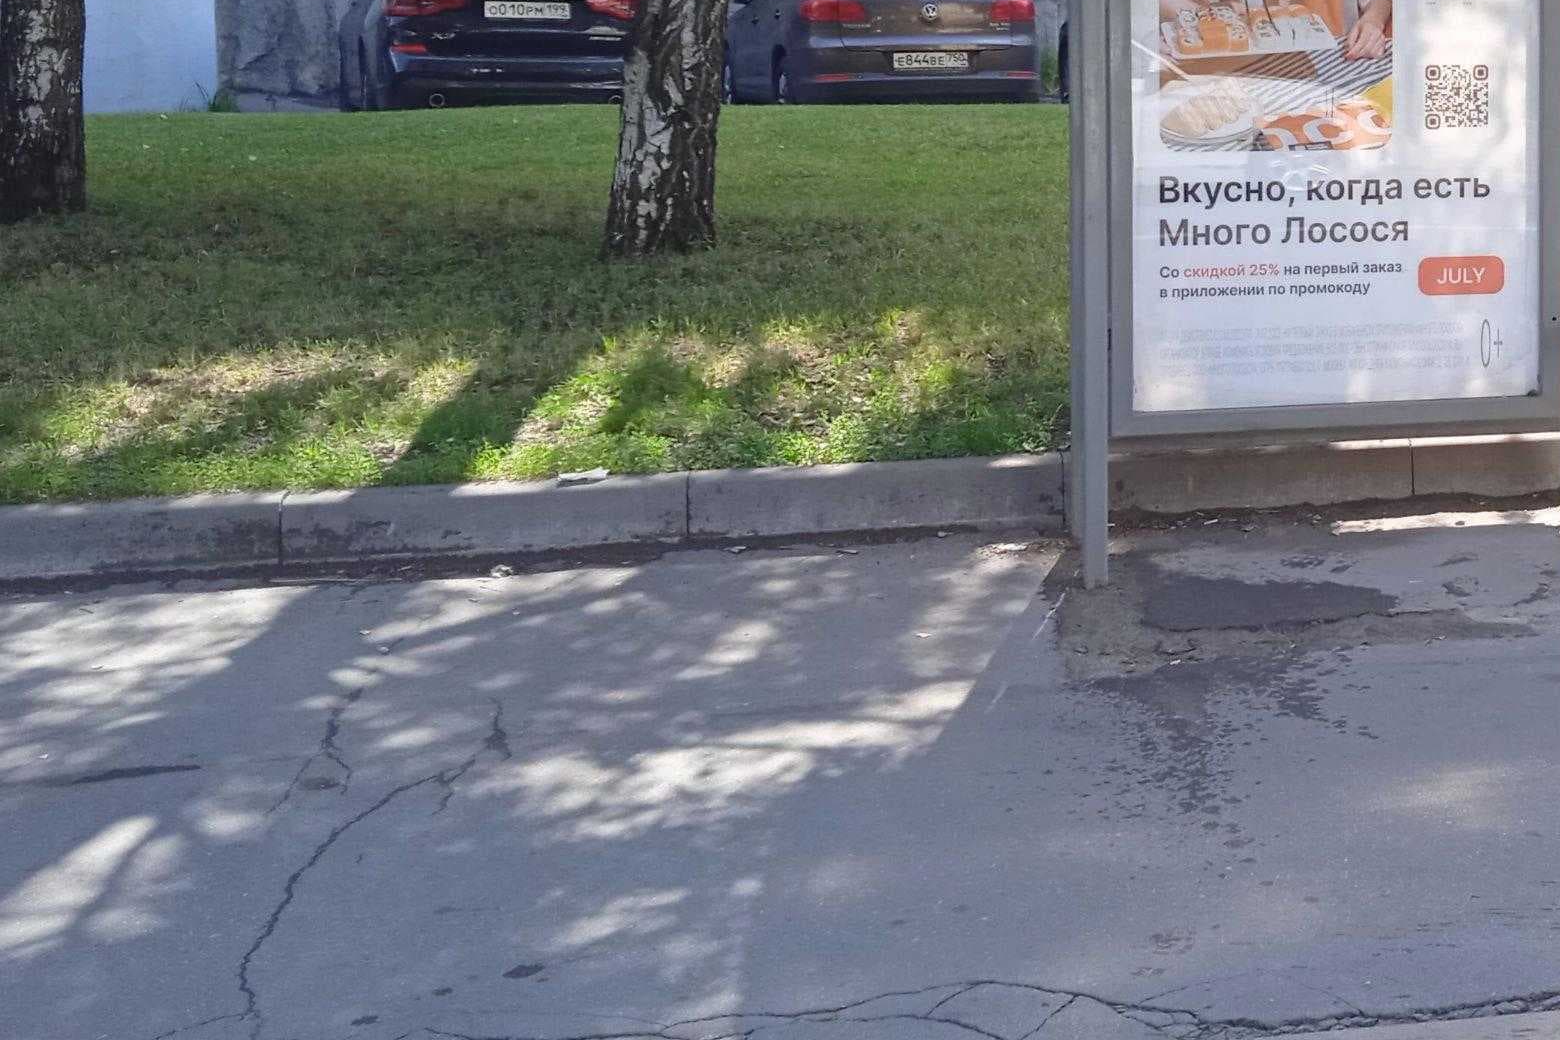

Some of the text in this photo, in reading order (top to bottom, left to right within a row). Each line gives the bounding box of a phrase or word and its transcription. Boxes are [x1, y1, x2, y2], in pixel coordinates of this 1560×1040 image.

[1159, 175, 1491, 210] Вкусно, когда есть
[1159, 216, 1409, 247] Много Лосося
[1159, 261, 1402, 280] Со скидкой 25% на первый заказ
[1436, 267, 1486, 285] JULY
[1159, 281, 1371, 301] в приложении по промокоду
